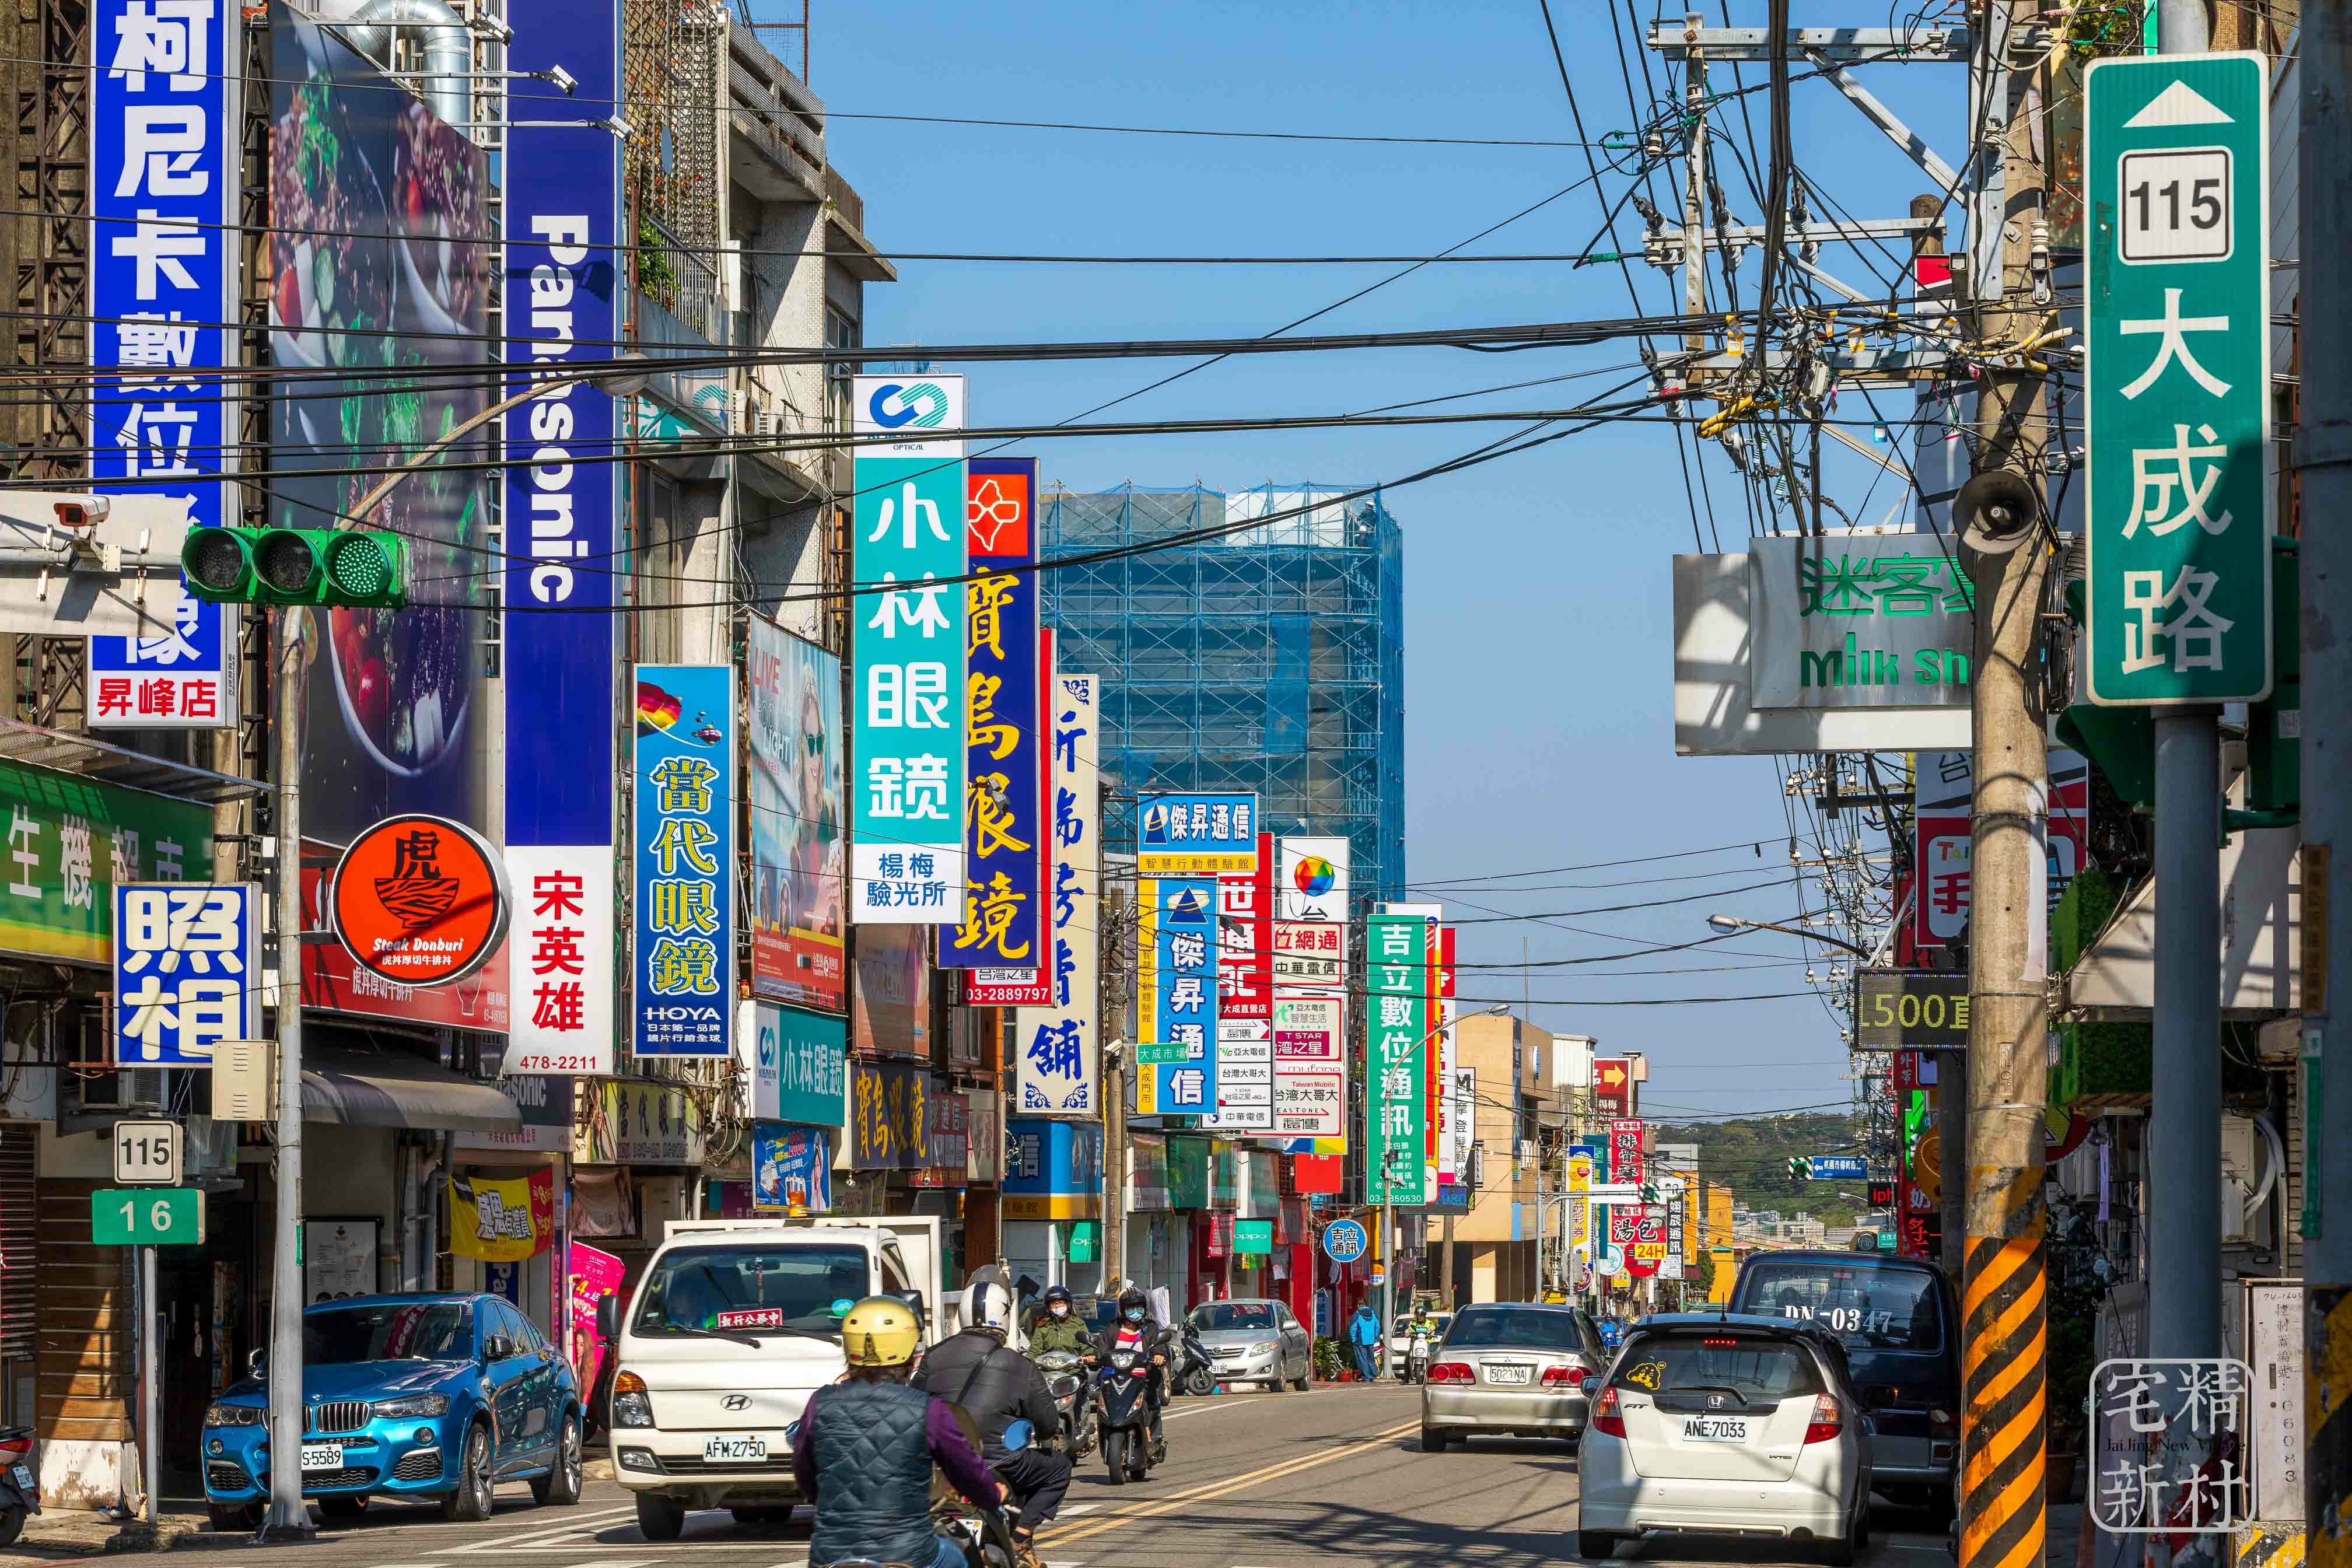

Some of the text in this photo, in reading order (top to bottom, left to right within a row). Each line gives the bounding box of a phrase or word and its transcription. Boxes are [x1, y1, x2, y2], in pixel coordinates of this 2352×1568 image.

[2130, 178, 2221, 231] 115
[108, 0, 214, 664] 柯尼卡數位像
[530, 215, 589, 603] Panasonic
[2119, 288, 2235, 675] 大成路
[868, 482, 950, 820] 小林眼鏡
[1801, 632, 1899, 687] Milk
[98, 678, 216, 718] 昇峰店
[1170, 803, 1251, 841] 傑昇通信
[394, 830, 441, 878] 虎
[879, 853, 934, 878] 楊梅
[1146, 858, 1250, 869] 智慧行動體驗館
[649, 756, 720, 996] 當代眼鏡
[867, 881, 946, 907] 驗光所
[373, 937, 464, 951] Steak Donburi
[532, 870, 584, 1031] 宋英雄
[382, 955, 452, 965] 虎丼厚切牛排丼
[1275, 963, 1336, 975] 中華電信
[123, 890, 244, 1060] 照相
[1142, 950, 1152, 1023] 智慧行動體驗館
[966, 988, 1048, 1000] 03-2889797
[643, 1007, 721, 1020] HOYA
[1169, 932, 1206, 1105] 傑昇通信
[1292, 1014, 1326, 1023] 智慧生活
[646, 1034, 720, 1043] 鏡片行銷全球
[647, 1023, 720, 1032] 日本第一品牌
[1380, 925, 1413, 1136] 吉立數位通訊
[520, 1056, 597, 1070] 478-2211
[1140, 1046, 1186, 1060] 大成市場
[1234, 1048, 1266, 1056] 亞太電信
[783, 1038, 843, 1097] 小林眼鏡
[1223, 1069, 1266, 1078] 台灣大哥大
[856, 1069, 927, 1161] 寶島眼鏡
[1226, 1112, 1265, 1121] 中華電信
[1283, 1118, 1319, 1129] 遠傳
[120, 1138, 170, 1166] 115
[1332, 1227, 1359, 1241] 吉立
[1614, 1219, 1657, 1241] 湯包
[1332, 1242, 1359, 1255] 通訊
